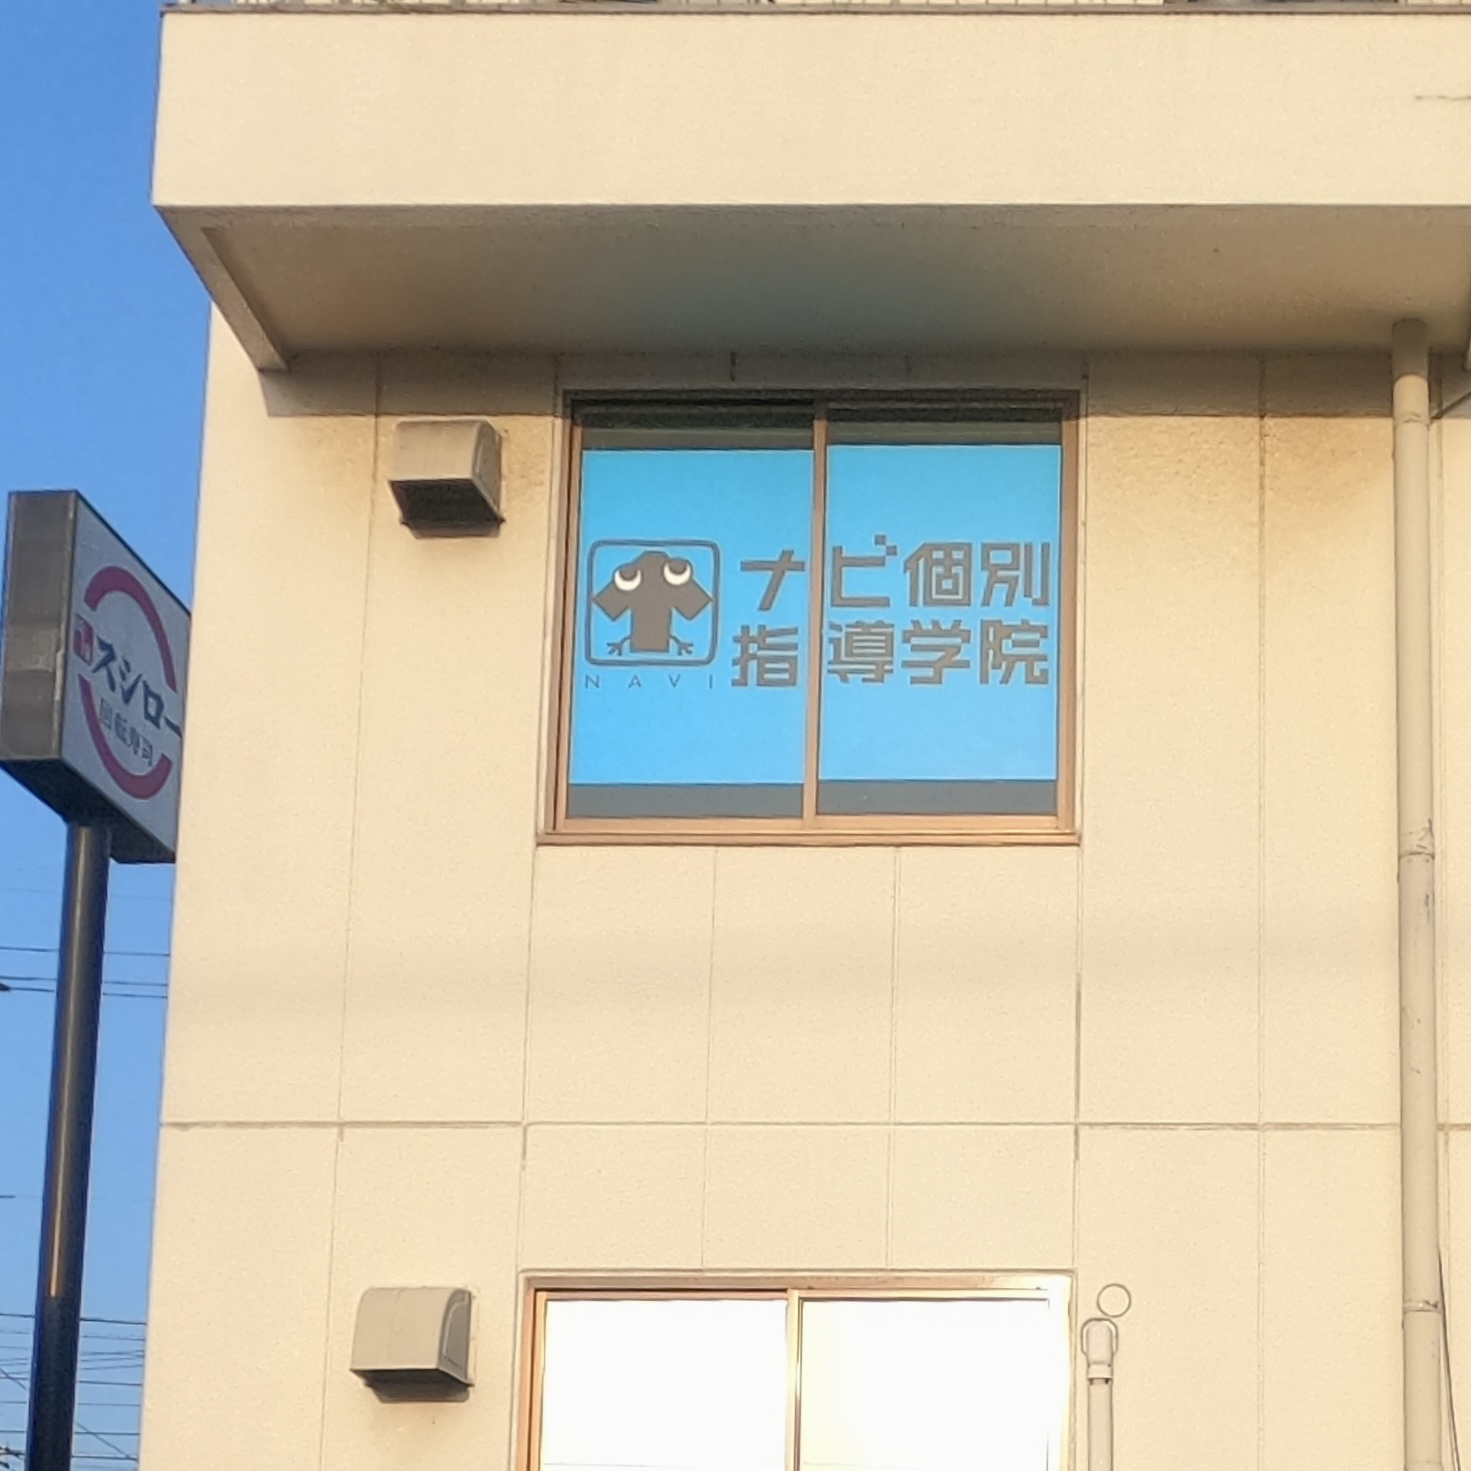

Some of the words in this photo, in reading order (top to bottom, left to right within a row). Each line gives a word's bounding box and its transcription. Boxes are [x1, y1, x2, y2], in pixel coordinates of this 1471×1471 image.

[740, 534, 1050, 611] ナビ個別
[91, 635, 183, 738] スシロー
[586, 673, 714, 690] NAVI
[732, 619, 1048, 687] 指導学院
